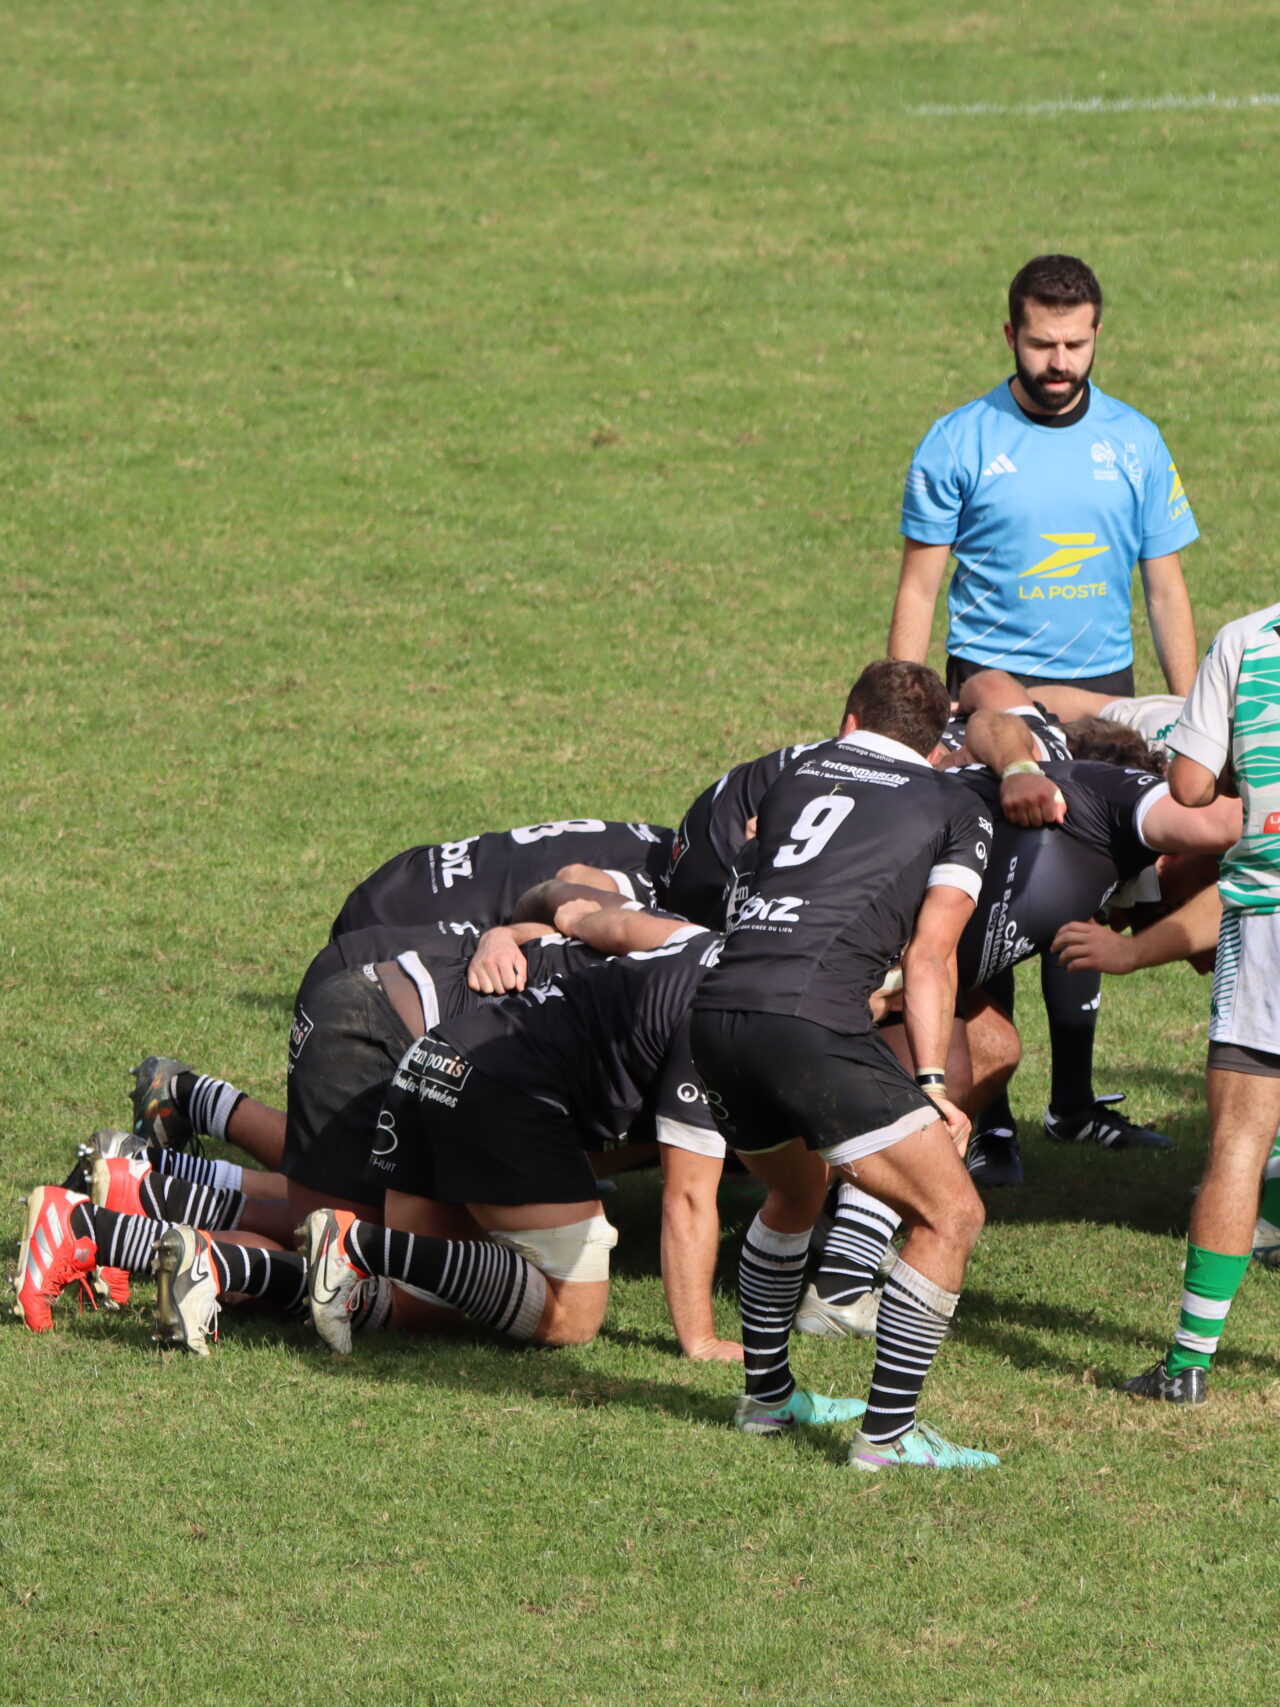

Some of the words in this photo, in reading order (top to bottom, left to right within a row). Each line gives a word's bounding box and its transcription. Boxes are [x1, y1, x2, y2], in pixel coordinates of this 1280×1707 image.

[1018, 586, 1044, 599] LA
[1049, 582, 1107, 599] POSTE
[773, 795, 856, 867] 9
[1007, 856, 1018, 883] DE
[408, 1046, 466, 1079] emporis
